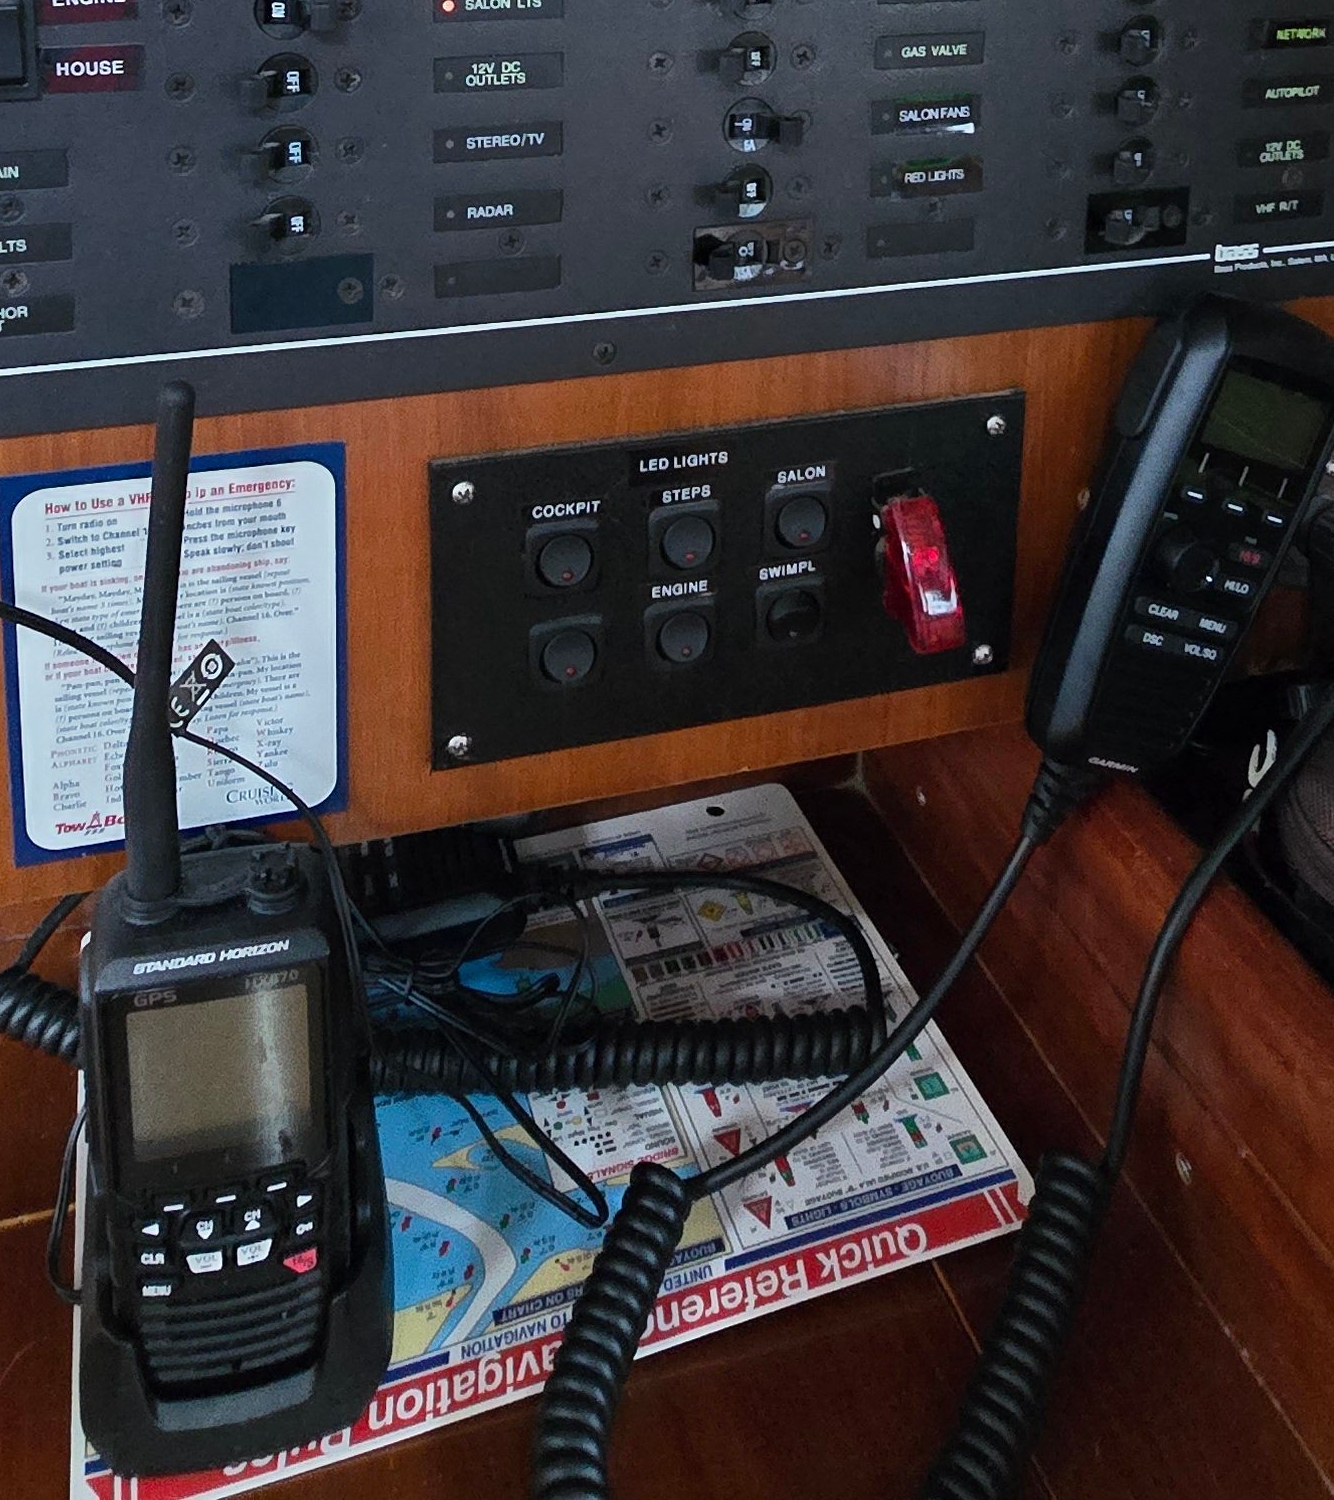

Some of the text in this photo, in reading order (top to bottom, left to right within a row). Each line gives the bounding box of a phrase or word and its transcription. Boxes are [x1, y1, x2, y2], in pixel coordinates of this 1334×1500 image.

[1275, 27, 1327, 41] NETWORK
[901, 43, 968, 58] GAS VALVE
[55, 59, 125, 78] HOUSE
[465, 61, 526, 87] 12V DC OUTLETS
[1265, 85, 1320, 99] AUTOPILOT
[466, 132, 545, 150] STEREO/TV
[1259, 140, 1305, 163] 12V DC OUTLETS
[904, 169, 965, 184] RED LIGHTS
[467, 204, 514, 219] RADAR
[1255, 200, 1299, 214] VHF R/T
[639, 451, 729, 474] LED LIGHTS
[777, 465, 827, 484] SALON
[210, 486, 225, 496] an
[229, 479, 296, 494] Emergency:
[661, 484, 712, 503] STEPS
[44, 492, 152, 515] How to Use a VHF
[531, 500, 601, 519] COCKPIT
[58, 543, 125, 560] Select highest
[59, 559, 122, 575] power setting
[758, 560, 817, 581] SWIMPL
[651, 580, 709, 600] ENGINE
[1148, 604, 1179, 620] CLEAR
[1199, 618, 1226, 634] MENU
[1142, 632, 1164, 646] DSC
[1088, 756, 1139, 773] GARMIN
[53, 780, 80, 791] Alpha
[133, 938, 290, 976] STANDARD HORIZON
[133, 989, 177, 1008] GPS
[901, 1167, 955, 1191] BUOYAGE
[839, 1187, 893, 1210] SYMBOLS
[244, 1208, 262, 1222] CH
[790, 1204, 831, 1227] LIGHTS
[140, 1252, 165, 1265] CLR
[814, 1221, 928, 1280] Quick
[664, 1263, 712, 1290] UNITED
[500, 1294, 564, 1322] ON CHART
[461, 1320, 547, 1359] NAVIGATION
[370, 1345, 556, 1428] avigation
